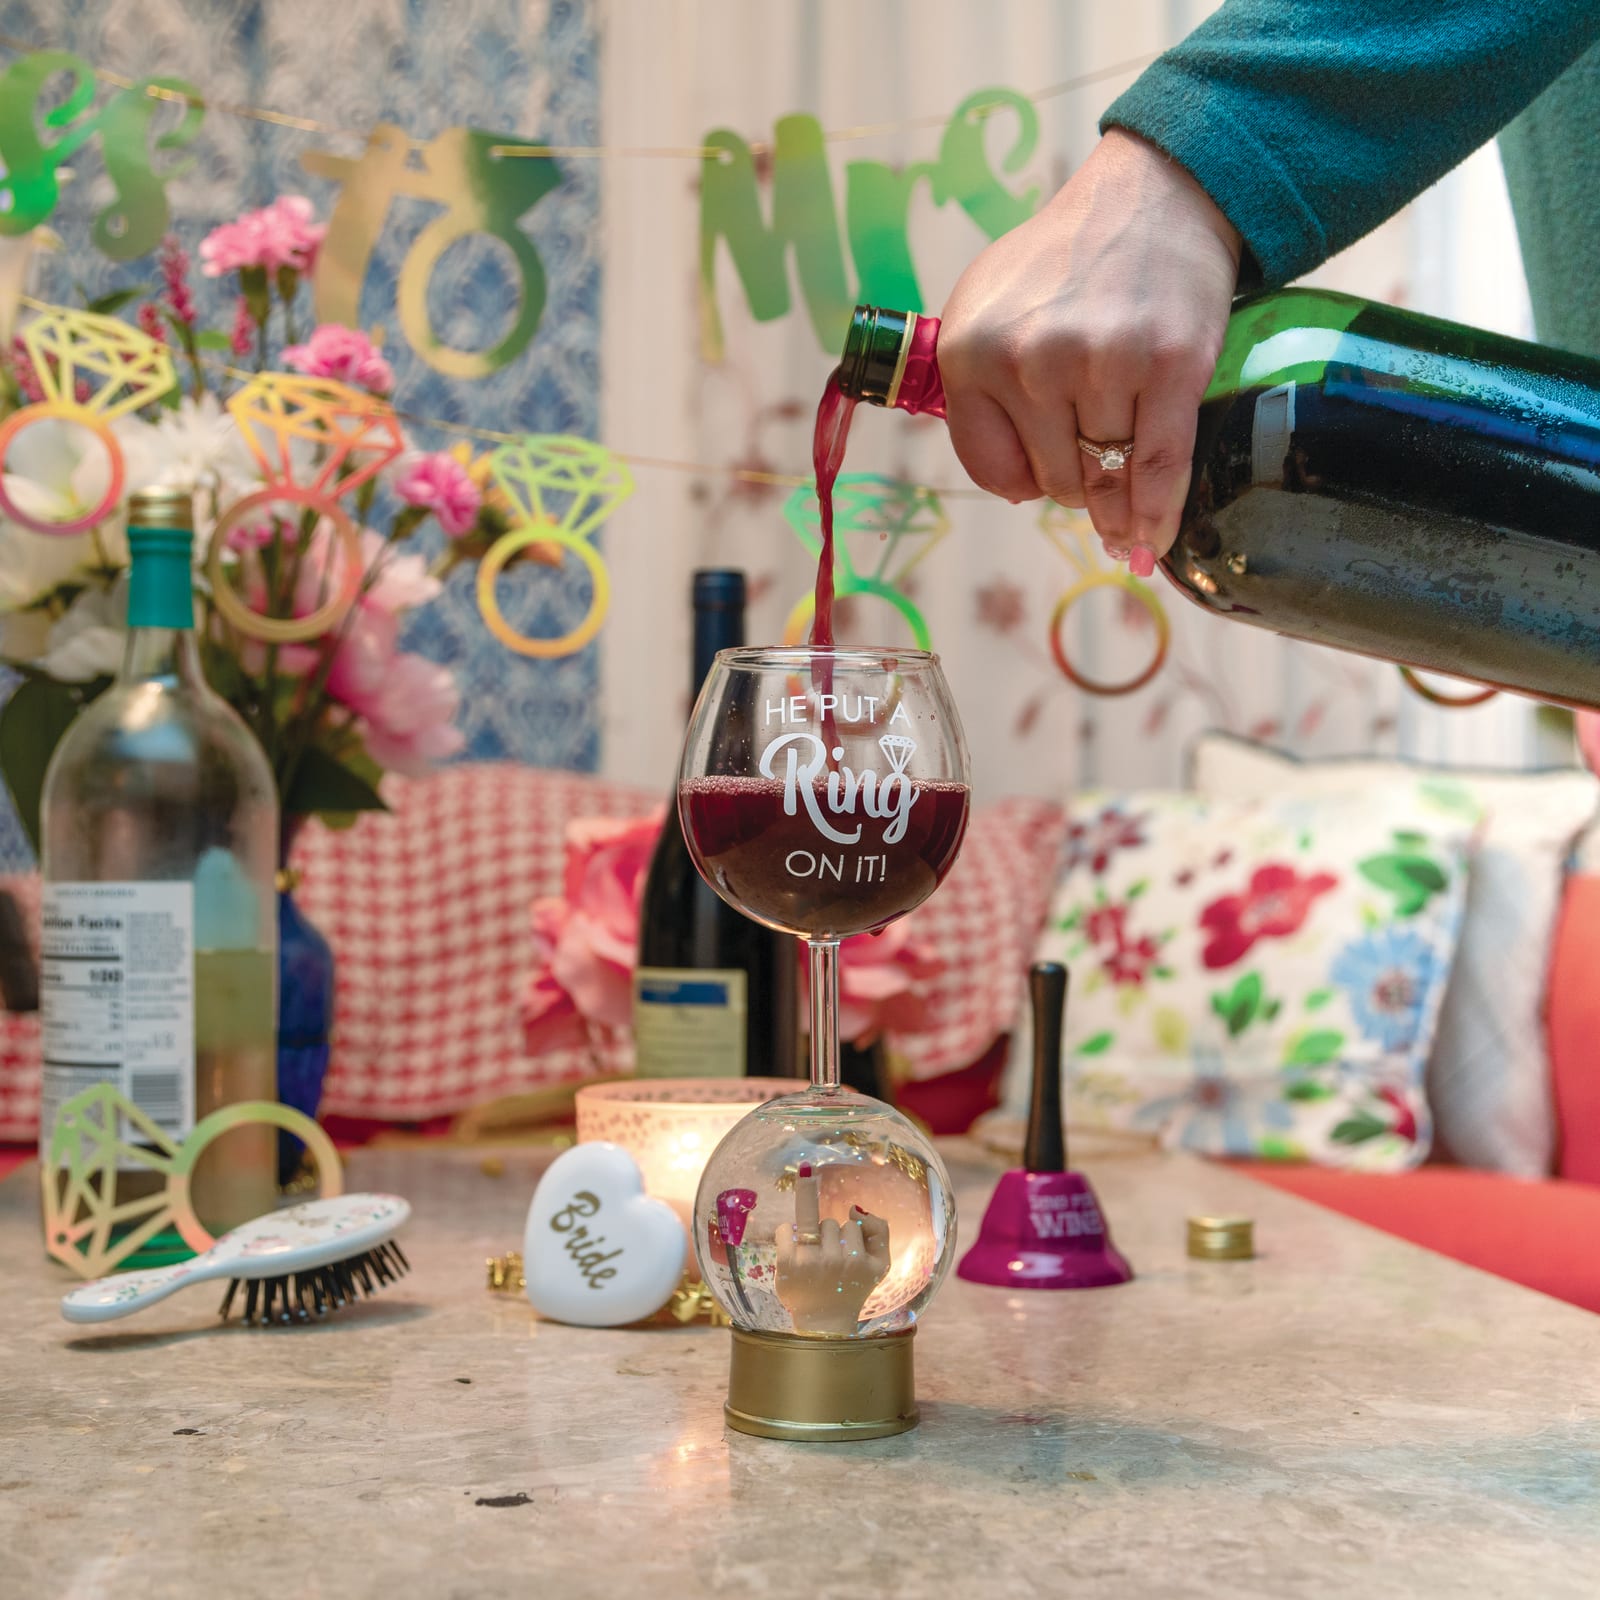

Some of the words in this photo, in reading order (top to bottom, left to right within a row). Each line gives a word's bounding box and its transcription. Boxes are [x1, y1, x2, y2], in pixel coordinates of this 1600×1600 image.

[696, 86, 1041, 365] Mrs
[765, 695, 808, 726] HE
[819, 693, 880, 724] PUT
[889, 700, 912, 728] A
[758, 732, 920, 845] Ring
[784, 849, 845, 882] ON
[855, 853, 887, 884] IT!
[77, 914, 123, 930] Facts
[550, 1189, 625, 1290] Bride
